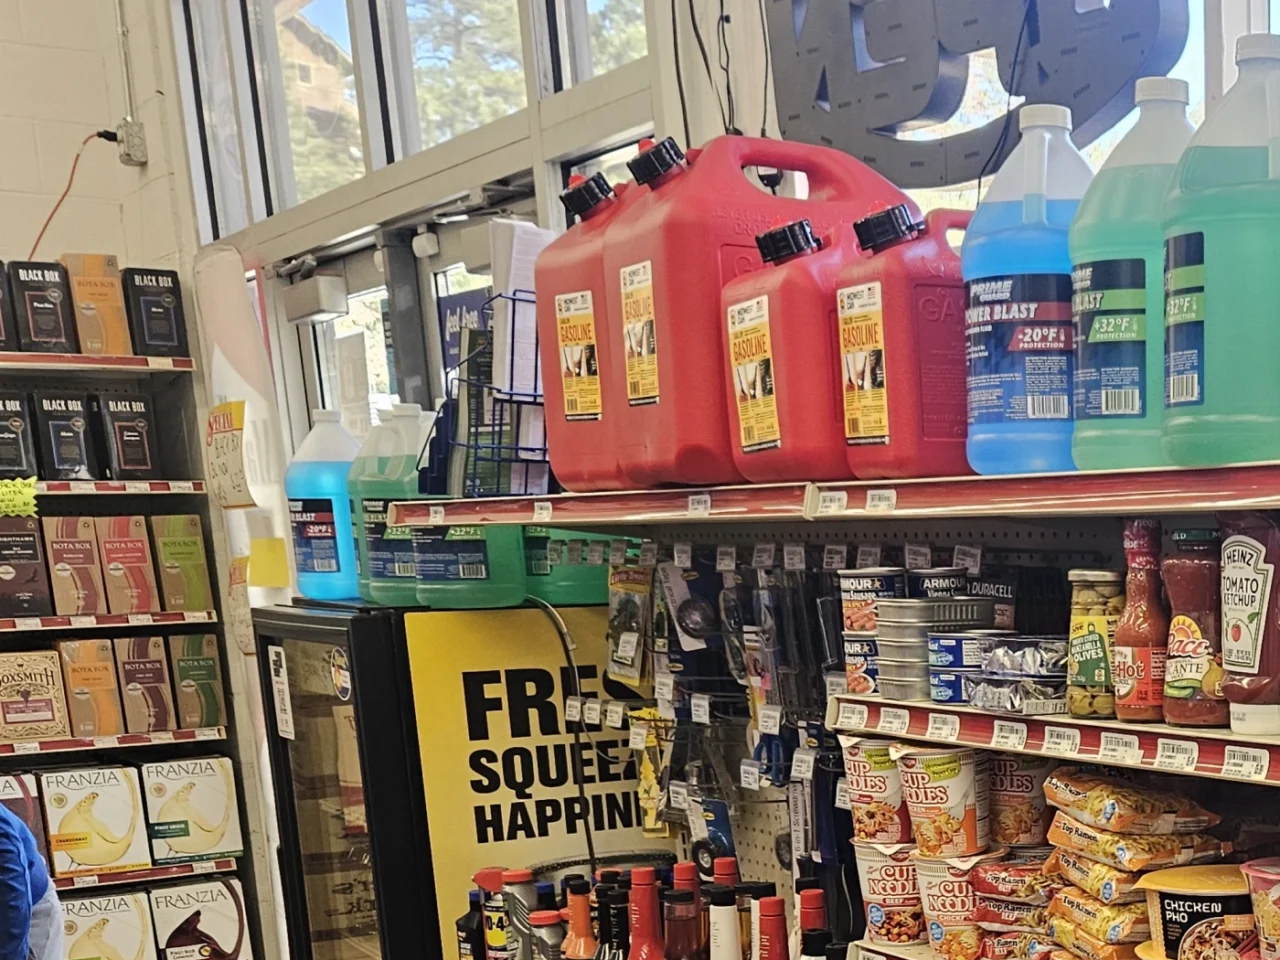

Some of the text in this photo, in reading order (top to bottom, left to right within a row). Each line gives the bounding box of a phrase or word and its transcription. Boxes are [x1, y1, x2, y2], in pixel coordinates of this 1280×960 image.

[19, 268, 60, 282] BLACK BOX
[134, 274, 173, 288] BLACK BOX
[970, 280, 1013, 295] PRIME
[979, 292, 1011, 302] GUARD
[994, 303, 1038, 320] BLAST
[560, 324, 592, 344] GASOLINE
[842, 324, 880, 345] GASOLINE
[733, 334, 768, 362] GASOLINE
[6, 400, 22, 412] BOX
[42, 399, 83, 411] BLACK BOX
[108, 400, 146, 412] BLACK BOX
[52, 540, 92, 549] BOTA BOX
[103, 539, 143, 549] BOTA BOX
[1225, 549, 1254, 567] HEINZ
[972, 583, 1013, 599] DURACELL
[1222, 577, 1259, 595] TOMATO
[1223, 592, 1257, 608] KETCHUP
[1073, 649, 1104, 662] OLIVES
[124, 662, 162, 672] BOTA BOX
[179, 659, 216, 668] BOTA BOX
[146, 762, 216, 780] FRANZIA
[46, 771, 120, 791] FRANZIA
[1074, 826, 1098, 842] Ramen
[155, 889, 228, 909] FRANZIA
[1164, 899, 1222, 914] CHICKEN
[1165, 909, 1188, 924] PHO
